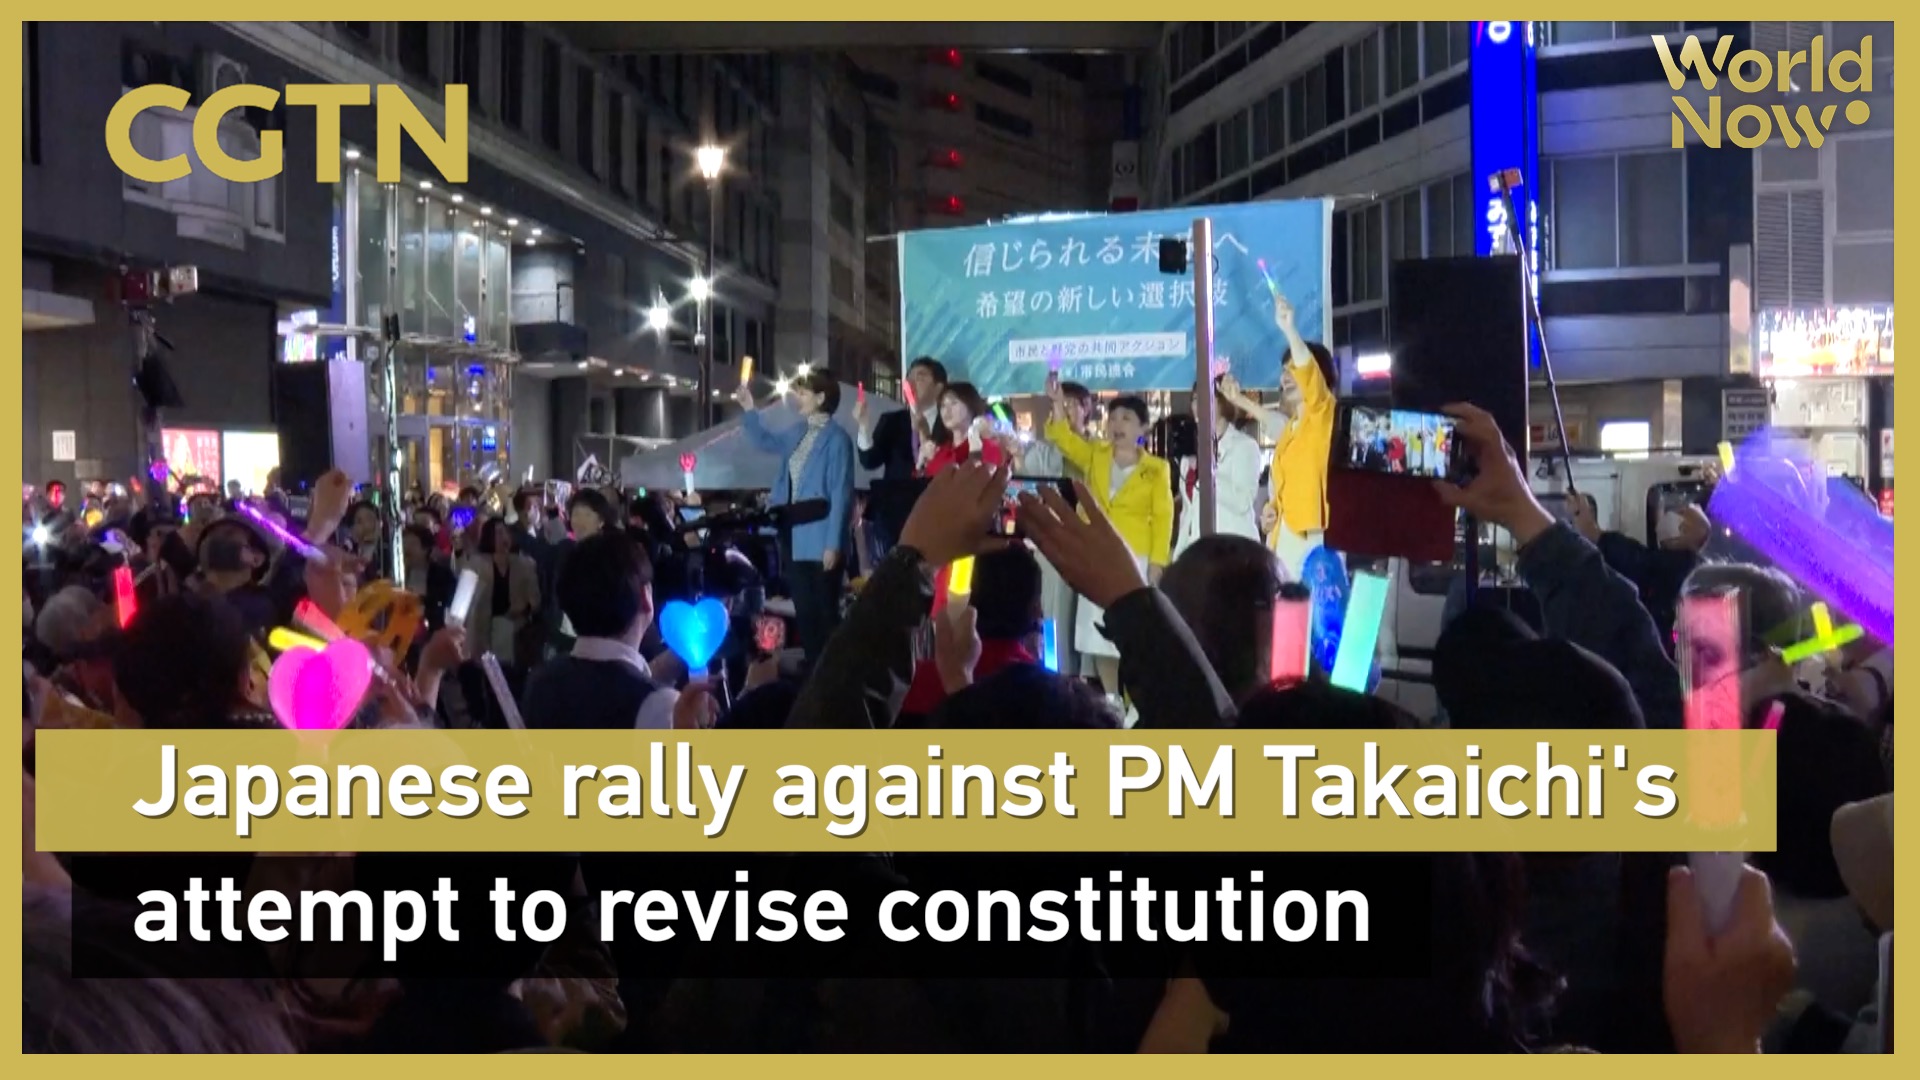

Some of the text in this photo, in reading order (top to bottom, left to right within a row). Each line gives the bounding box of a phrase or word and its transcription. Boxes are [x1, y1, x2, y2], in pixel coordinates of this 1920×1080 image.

[964, 227, 1249, 278] 信じられる未へ
